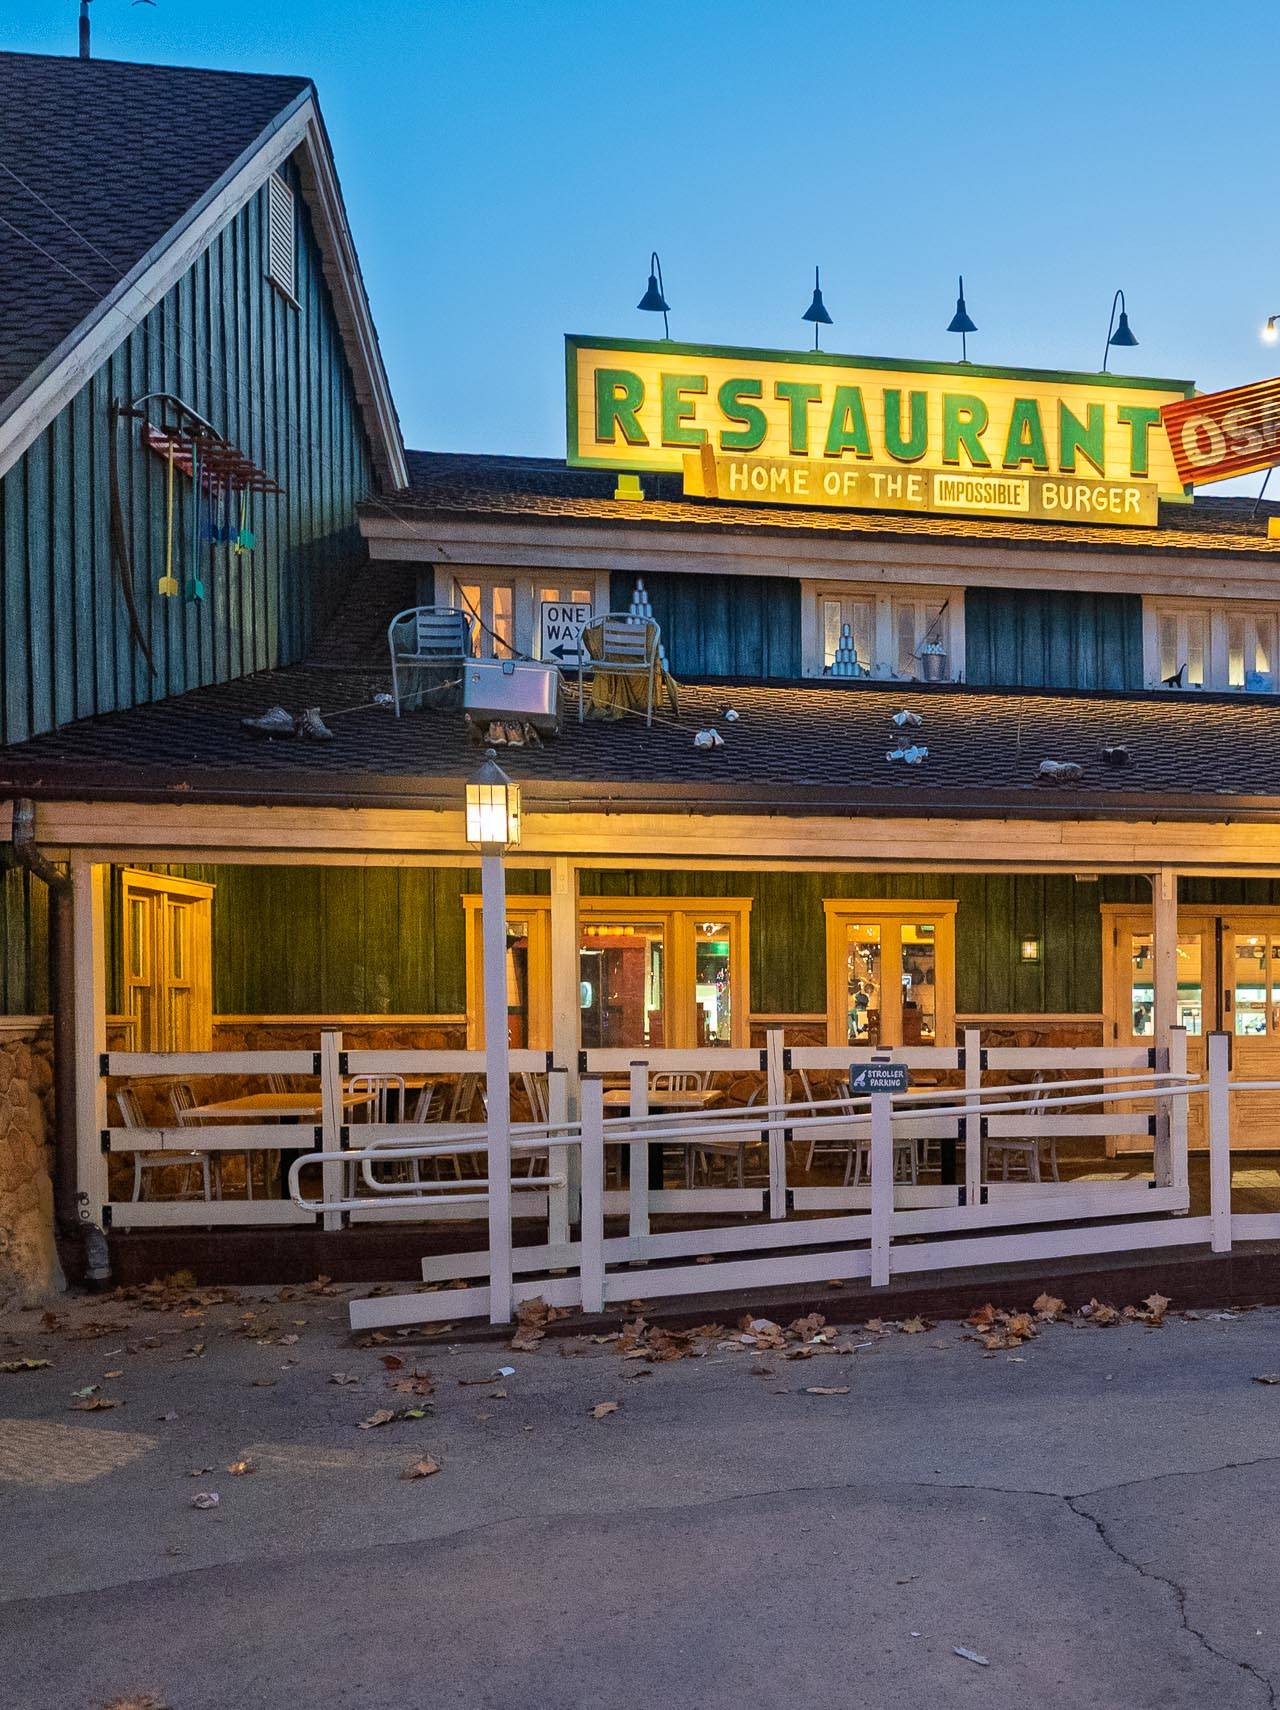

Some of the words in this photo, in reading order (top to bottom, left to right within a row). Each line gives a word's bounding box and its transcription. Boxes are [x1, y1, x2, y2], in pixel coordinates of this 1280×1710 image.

[594, 368, 1162, 478] RESTAURANT
[729, 463, 810, 495] HOME
[823, 471, 859, 496] OF
[868, 472, 923, 502] THE
[939, 479, 1021, 506] IMPOSSIBLE
[1041, 482, 1141, 513] BURGER
[547, 607, 586, 623] ONE
[867, 1070, 904, 1078] STROLLER
[870, 1078, 901, 1087] PARKING
